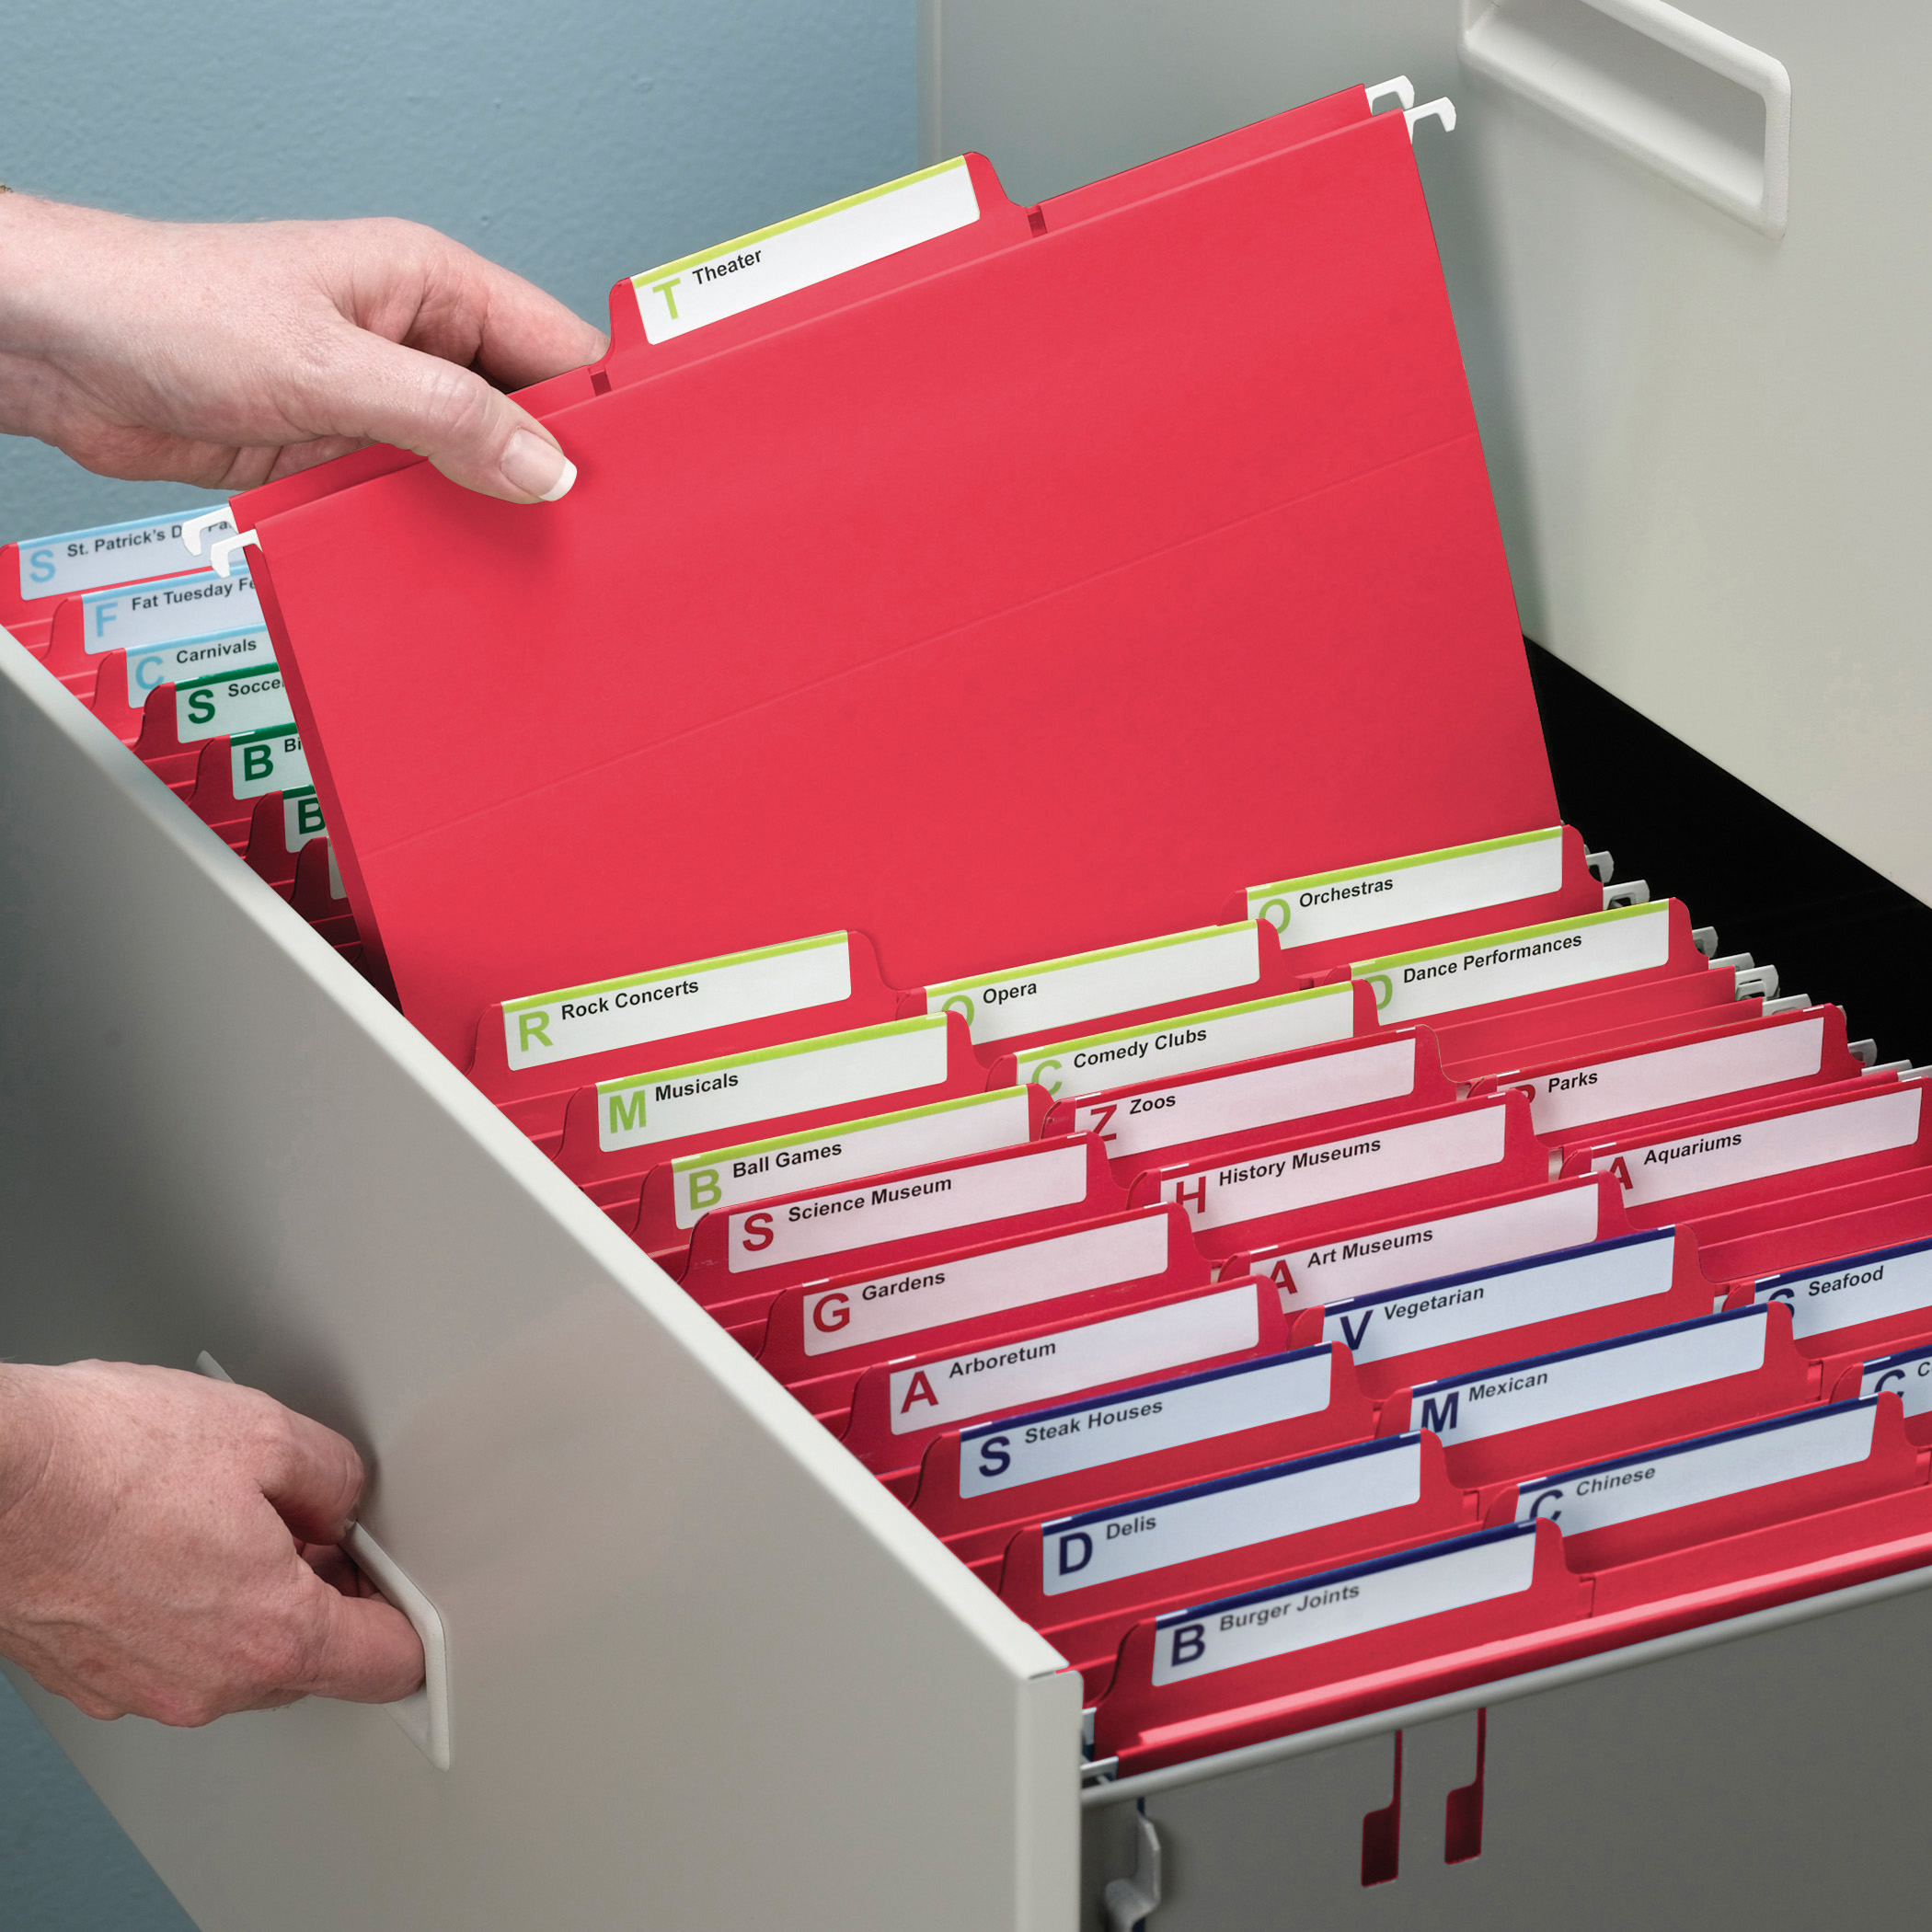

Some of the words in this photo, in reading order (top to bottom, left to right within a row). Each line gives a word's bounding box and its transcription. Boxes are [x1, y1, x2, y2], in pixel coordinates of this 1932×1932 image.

[692, 248, 762, 285] Theater
[652, 277, 681, 320] T
[67, 544, 88, 557] St.
[95, 529, 166, 553] Patrick's
[29, 549, 56, 583] S
[132, 596, 159, 611] Fat
[164, 582, 233, 604] Tuesday
[95, 602, 119, 638] F
[176, 639, 257, 664] Carnivals
[135, 656, 164, 690] C
[188, 689, 216, 724] S
[244, 744, 273, 781] B
[298, 797, 327, 834] B
[1299, 878, 1394, 908] Orchestras
[1404, 960, 1458, 984] Dance
[1463, 934, 1582, 971] Performances
[561, 997, 609, 1020] Rock
[615, 979, 699, 1008] Concerts
[983, 981, 1038, 1006] Opera
[518, 1010, 554, 1052] R
[1074, 1040, 1149, 1069] Comedy
[1156, 1028, 1207, 1051] Clubs
[655, 1073, 739, 1102] Musicals
[1031, 1059, 1063, 1096] C
[1548, 1071, 1598, 1094] Parks
[609, 1090, 647, 1133] M
[1090, 1104, 1117, 1142] Z
[1130, 1094, 1176, 1115] Zoos
[733, 1156, 769, 1179] Ball
[776, 1142, 842, 1168] Games
[1219, 1159, 1286, 1187] History
[1292, 1139, 1381, 1171] Museums
[1643, 1133, 1742, 1166] Aquariums
[688, 1167, 722, 1211] B
[788, 1196, 865, 1223] Science
[871, 1178, 952, 1205] Museum
[1177, 1176, 1206, 1214] H
[742, 1213, 775, 1251] S
[1307, 1249, 1338, 1268] Art
[1342, 1229, 1433, 1261] Museums
[862, 1271, 946, 1302] Gardens
[1809, 1266, 1884, 1297] Seafood
[812, 1293, 850, 1333] G
[1384, 1286, 1484, 1321] Vegetarian
[1340, 1309, 1374, 1351] V
[949, 1341, 1056, 1379] Arboretum
[901, 1371, 939, 1414] A
[1468, 1371, 1548, 1404] Mexican
[1025, 1419, 1081, 1445] Steak
[1087, 1401, 1164, 1430] Houses
[1420, 1390, 1460, 1433] M
[978, 1436, 1012, 1478] S
[1576, 1466, 1656, 1498] Chinese
[1106, 1514, 1156, 1541] Delis
[1058, 1531, 1093, 1576] D
[1220, 1603, 1291, 1632] Burger
[1297, 1583, 1360, 1612] Joints
[1171, 1623, 1206, 1668] B
